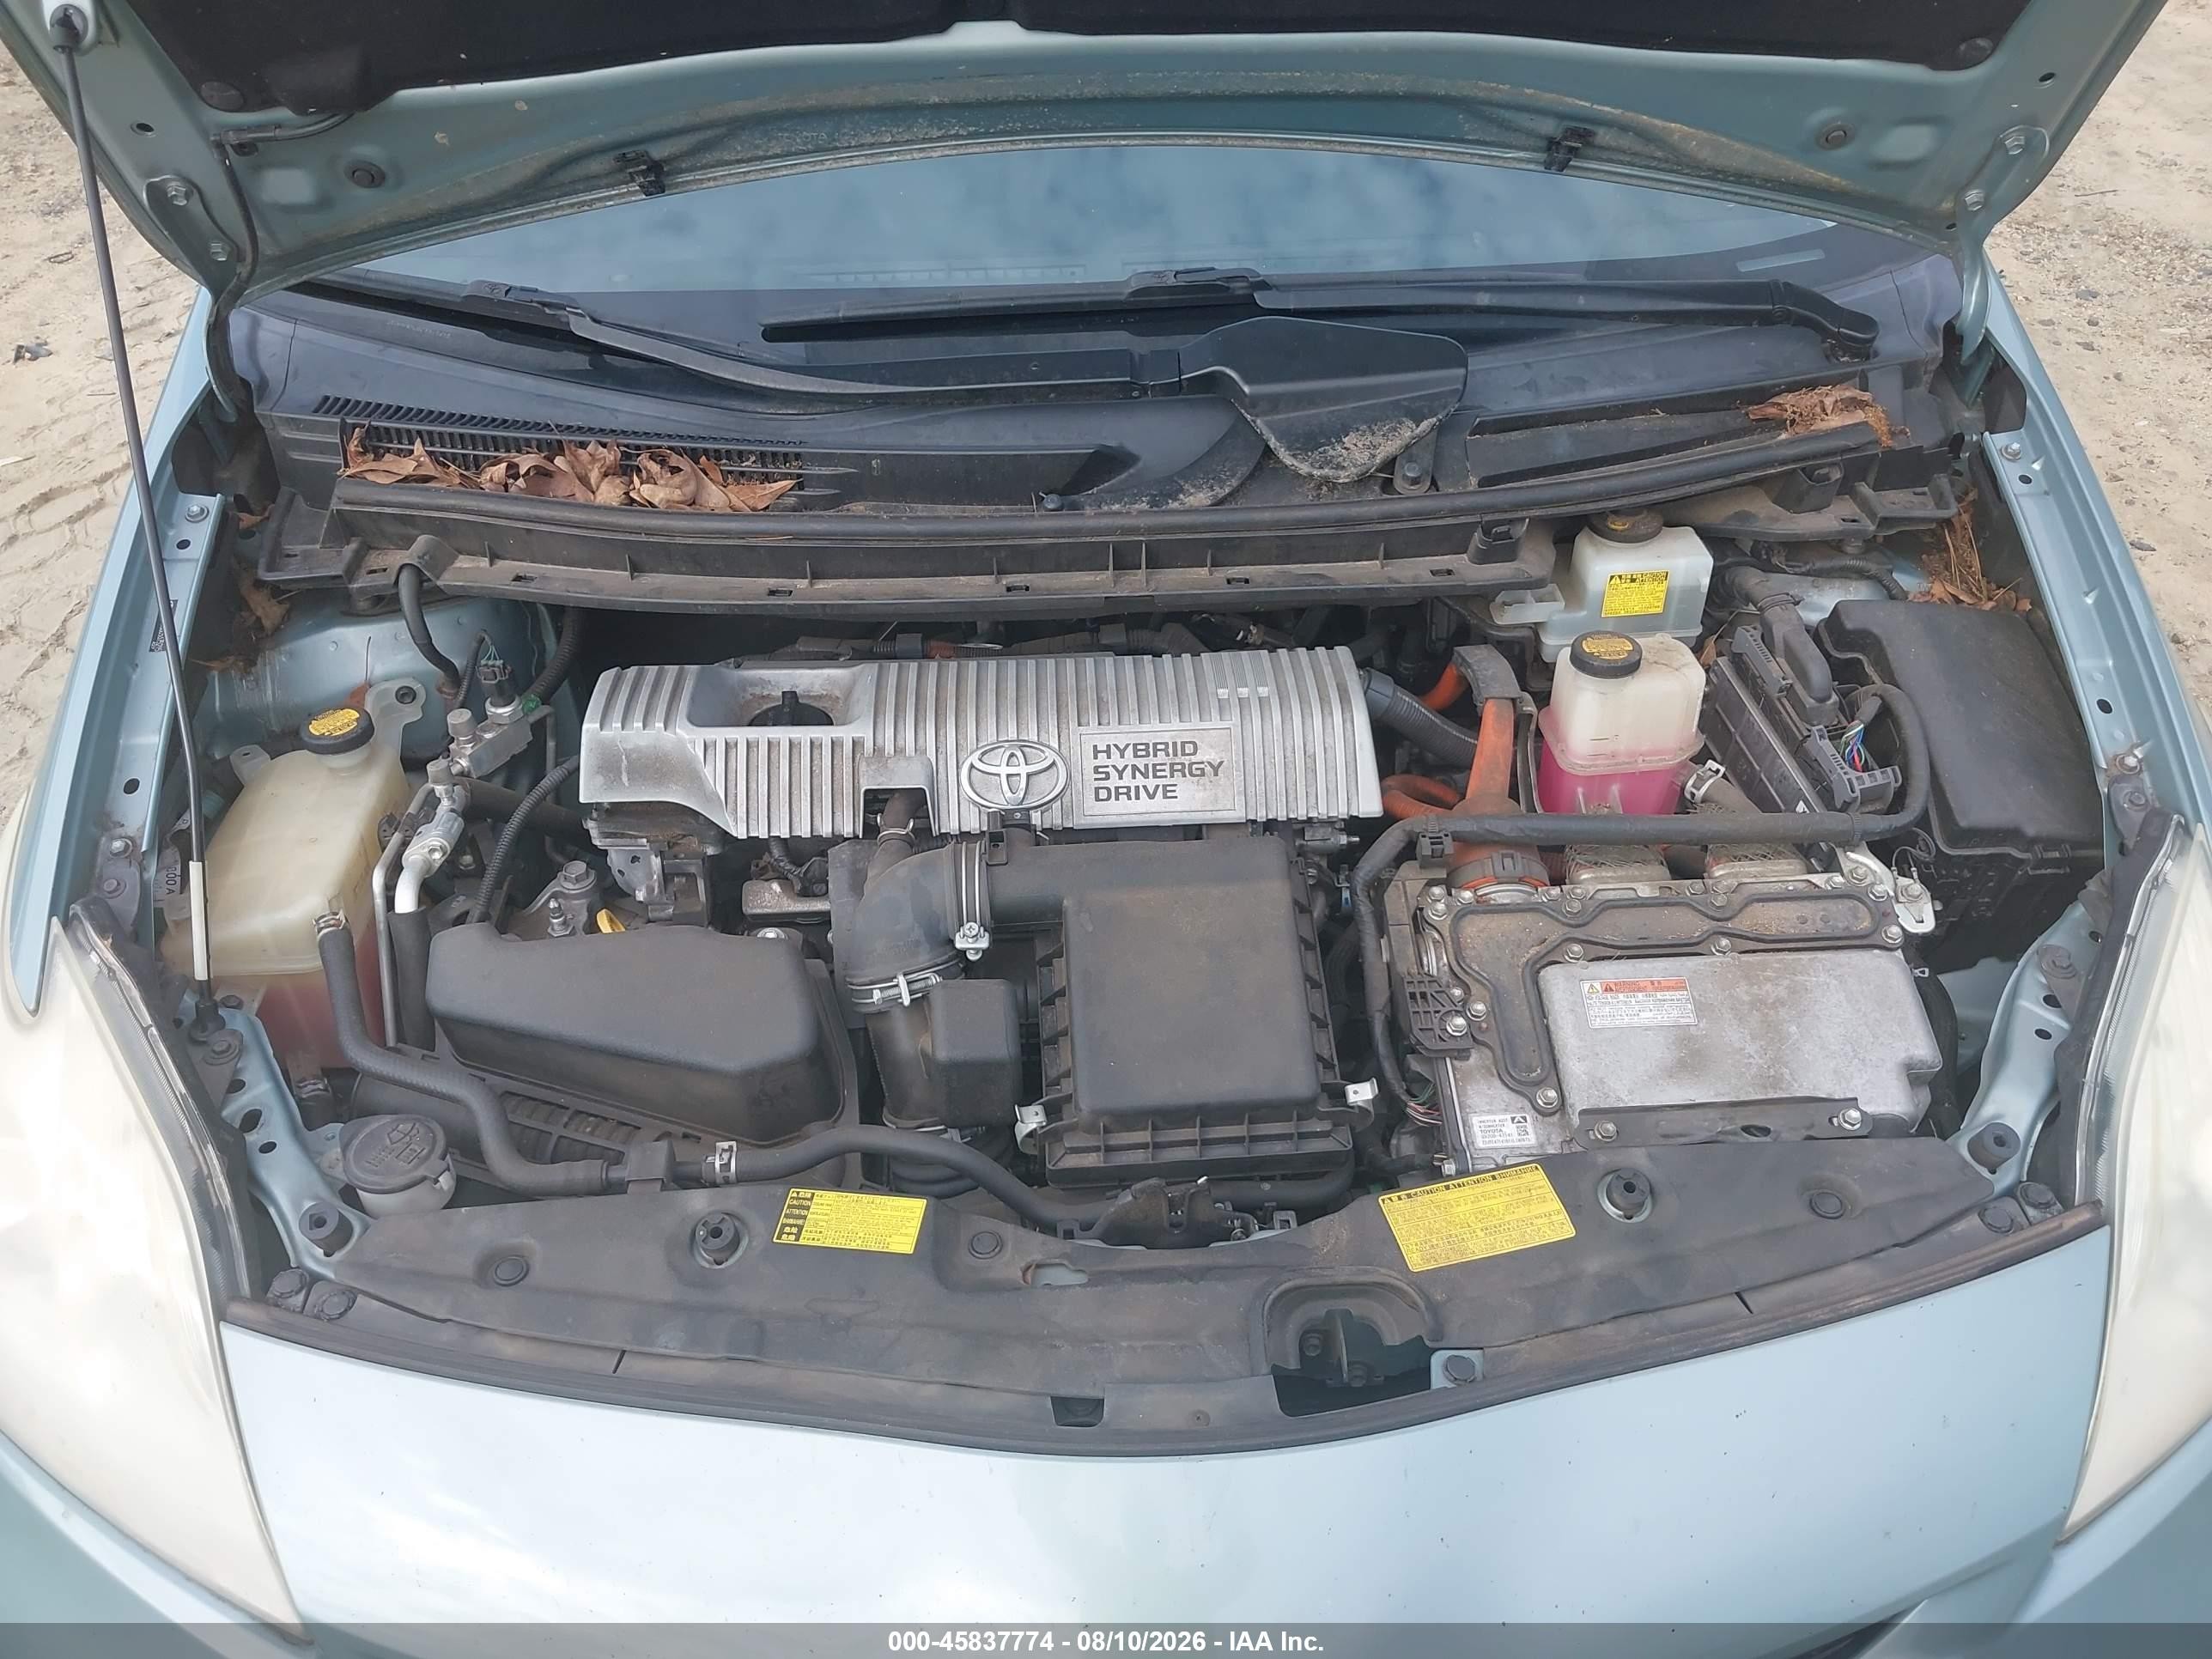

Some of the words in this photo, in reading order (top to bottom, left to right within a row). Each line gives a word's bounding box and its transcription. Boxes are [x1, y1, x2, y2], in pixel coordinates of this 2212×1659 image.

[1092, 740, 1199, 760] HYBRID
[1093, 760, 1225, 781] SYNERGY
[1094, 783, 1179, 803] DRIVE
[1411, 1186, 1446, 1200] CAUTION
[1449, 1176, 1493, 1191] ATTENTION
[785, 1208, 809, 1217] ATTENTION
